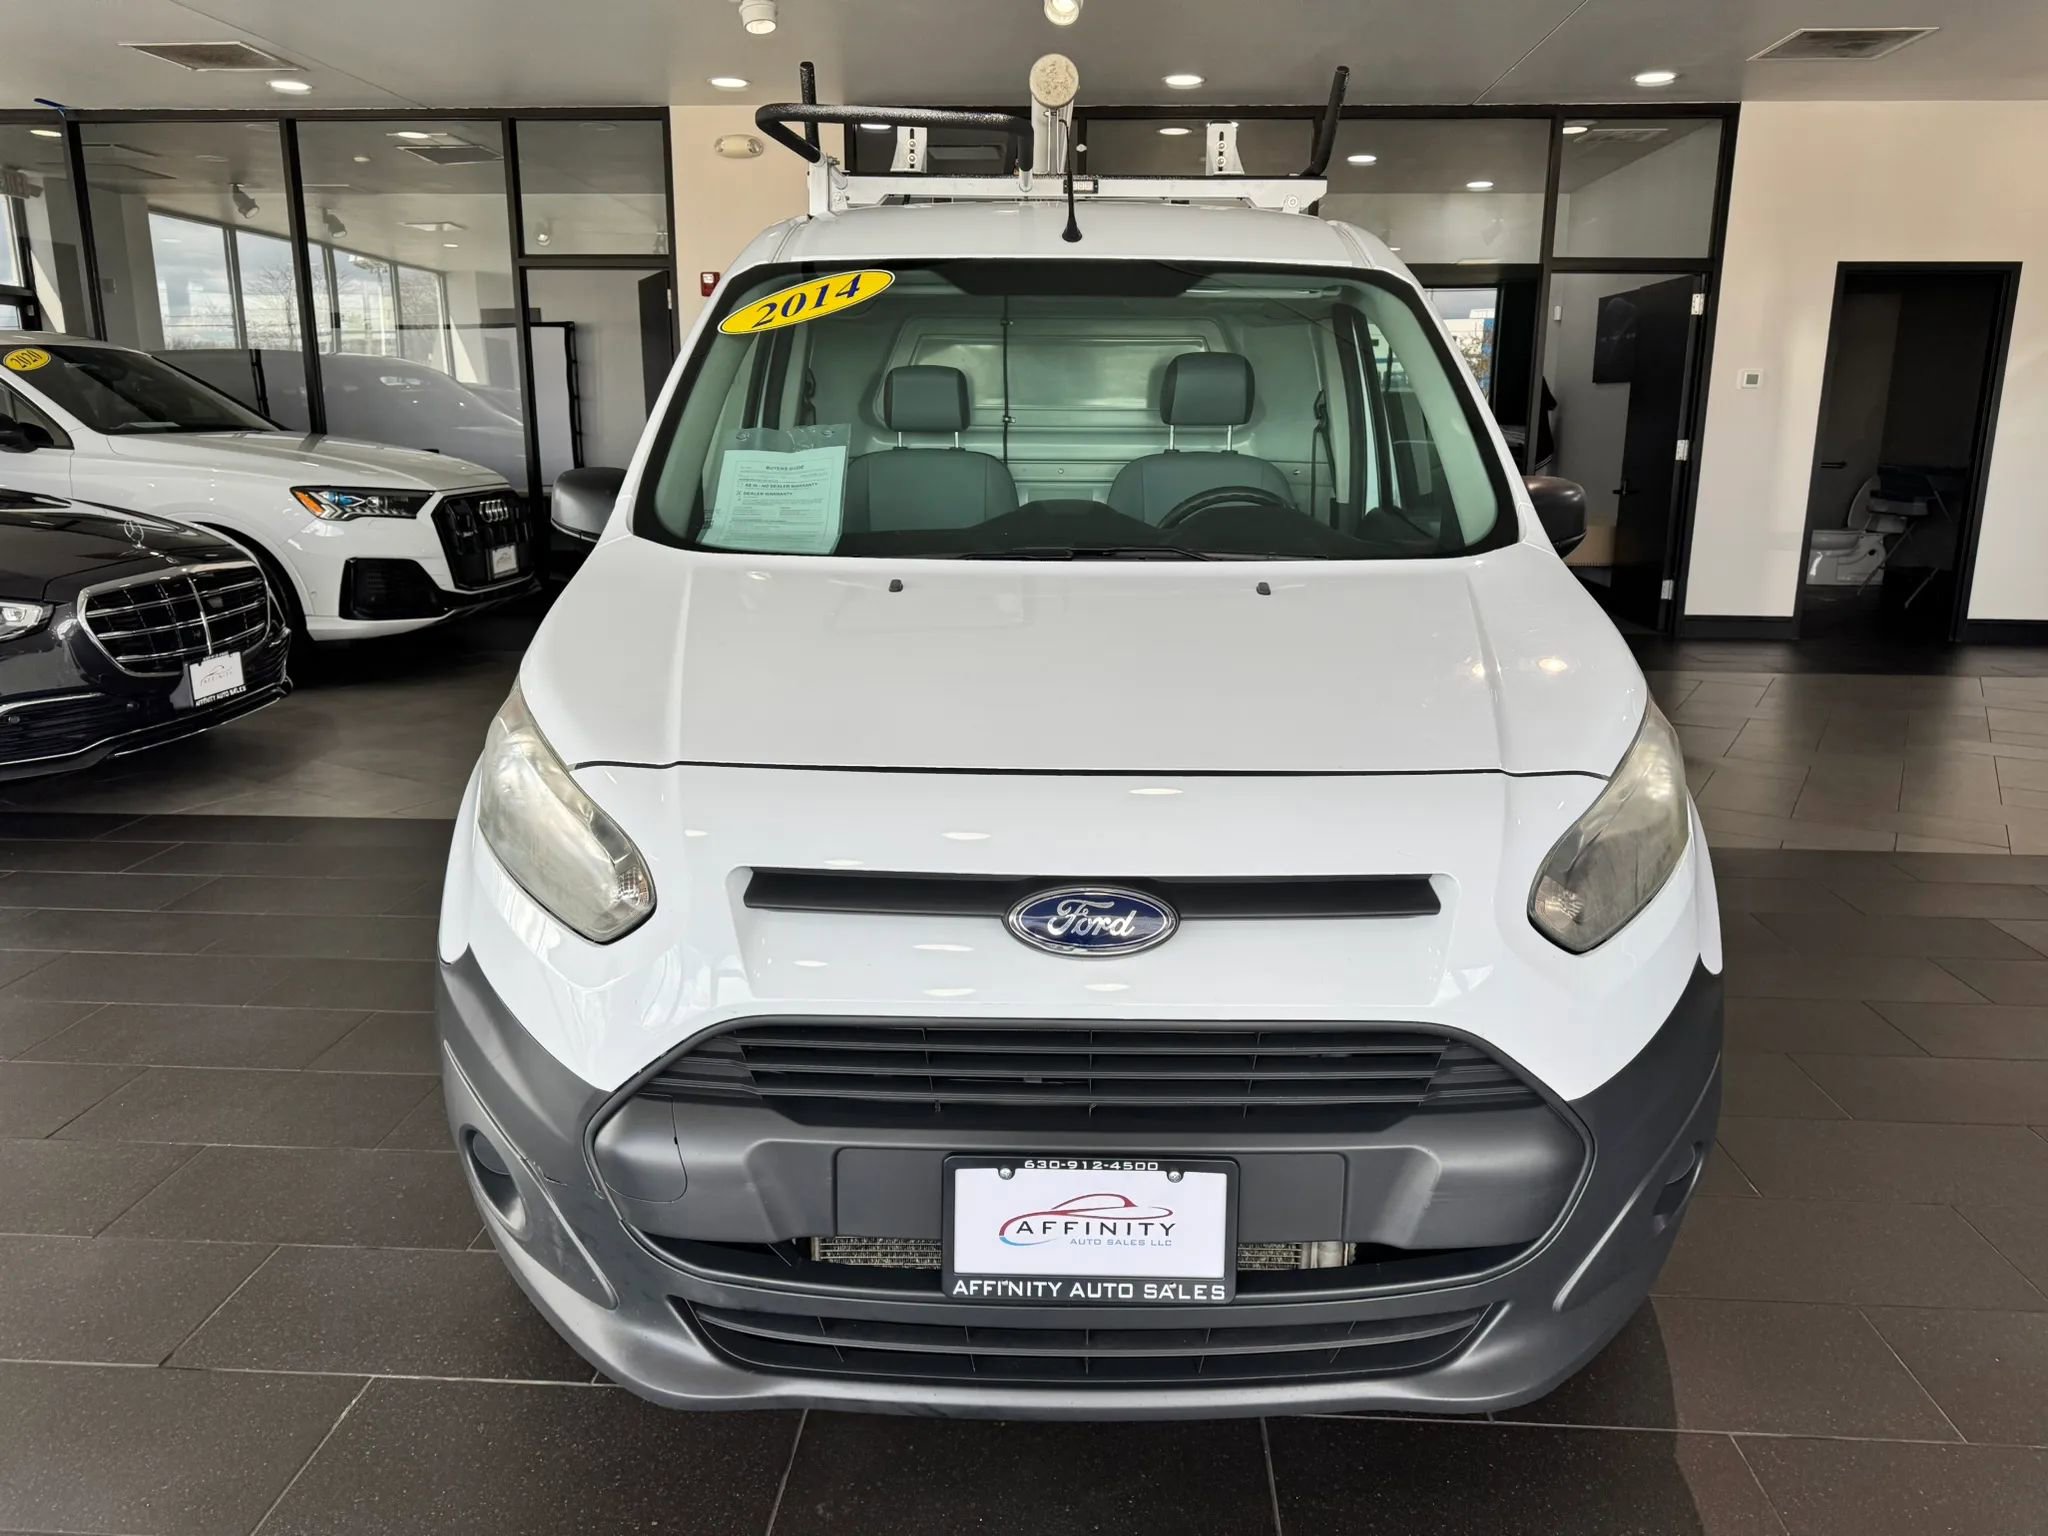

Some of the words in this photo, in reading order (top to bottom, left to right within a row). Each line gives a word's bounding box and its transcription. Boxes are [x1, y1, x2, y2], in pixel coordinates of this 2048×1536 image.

[752, 274, 861, 328] 2014
[10, 350, 42, 368] 2020
[216, 690, 230, 700] AUTO
[229, 685, 247, 696] SALES
[1047, 899, 1137, 936] Ford
[1024, 1159, 1159, 1171] 630-912-4500
[1016, 1221, 1176, 1236] AFFINITY
[1070, 1238, 1102, 1246] AUTO
[1107, 1239, 1146, 1247] SALES
[1151, 1239, 1172, 1247] LLC
[952, 1280, 1062, 1297] AFFINITY
[1069, 1282, 1133, 1299] AUTO
[1144, 1284, 1225, 1300] SALES
